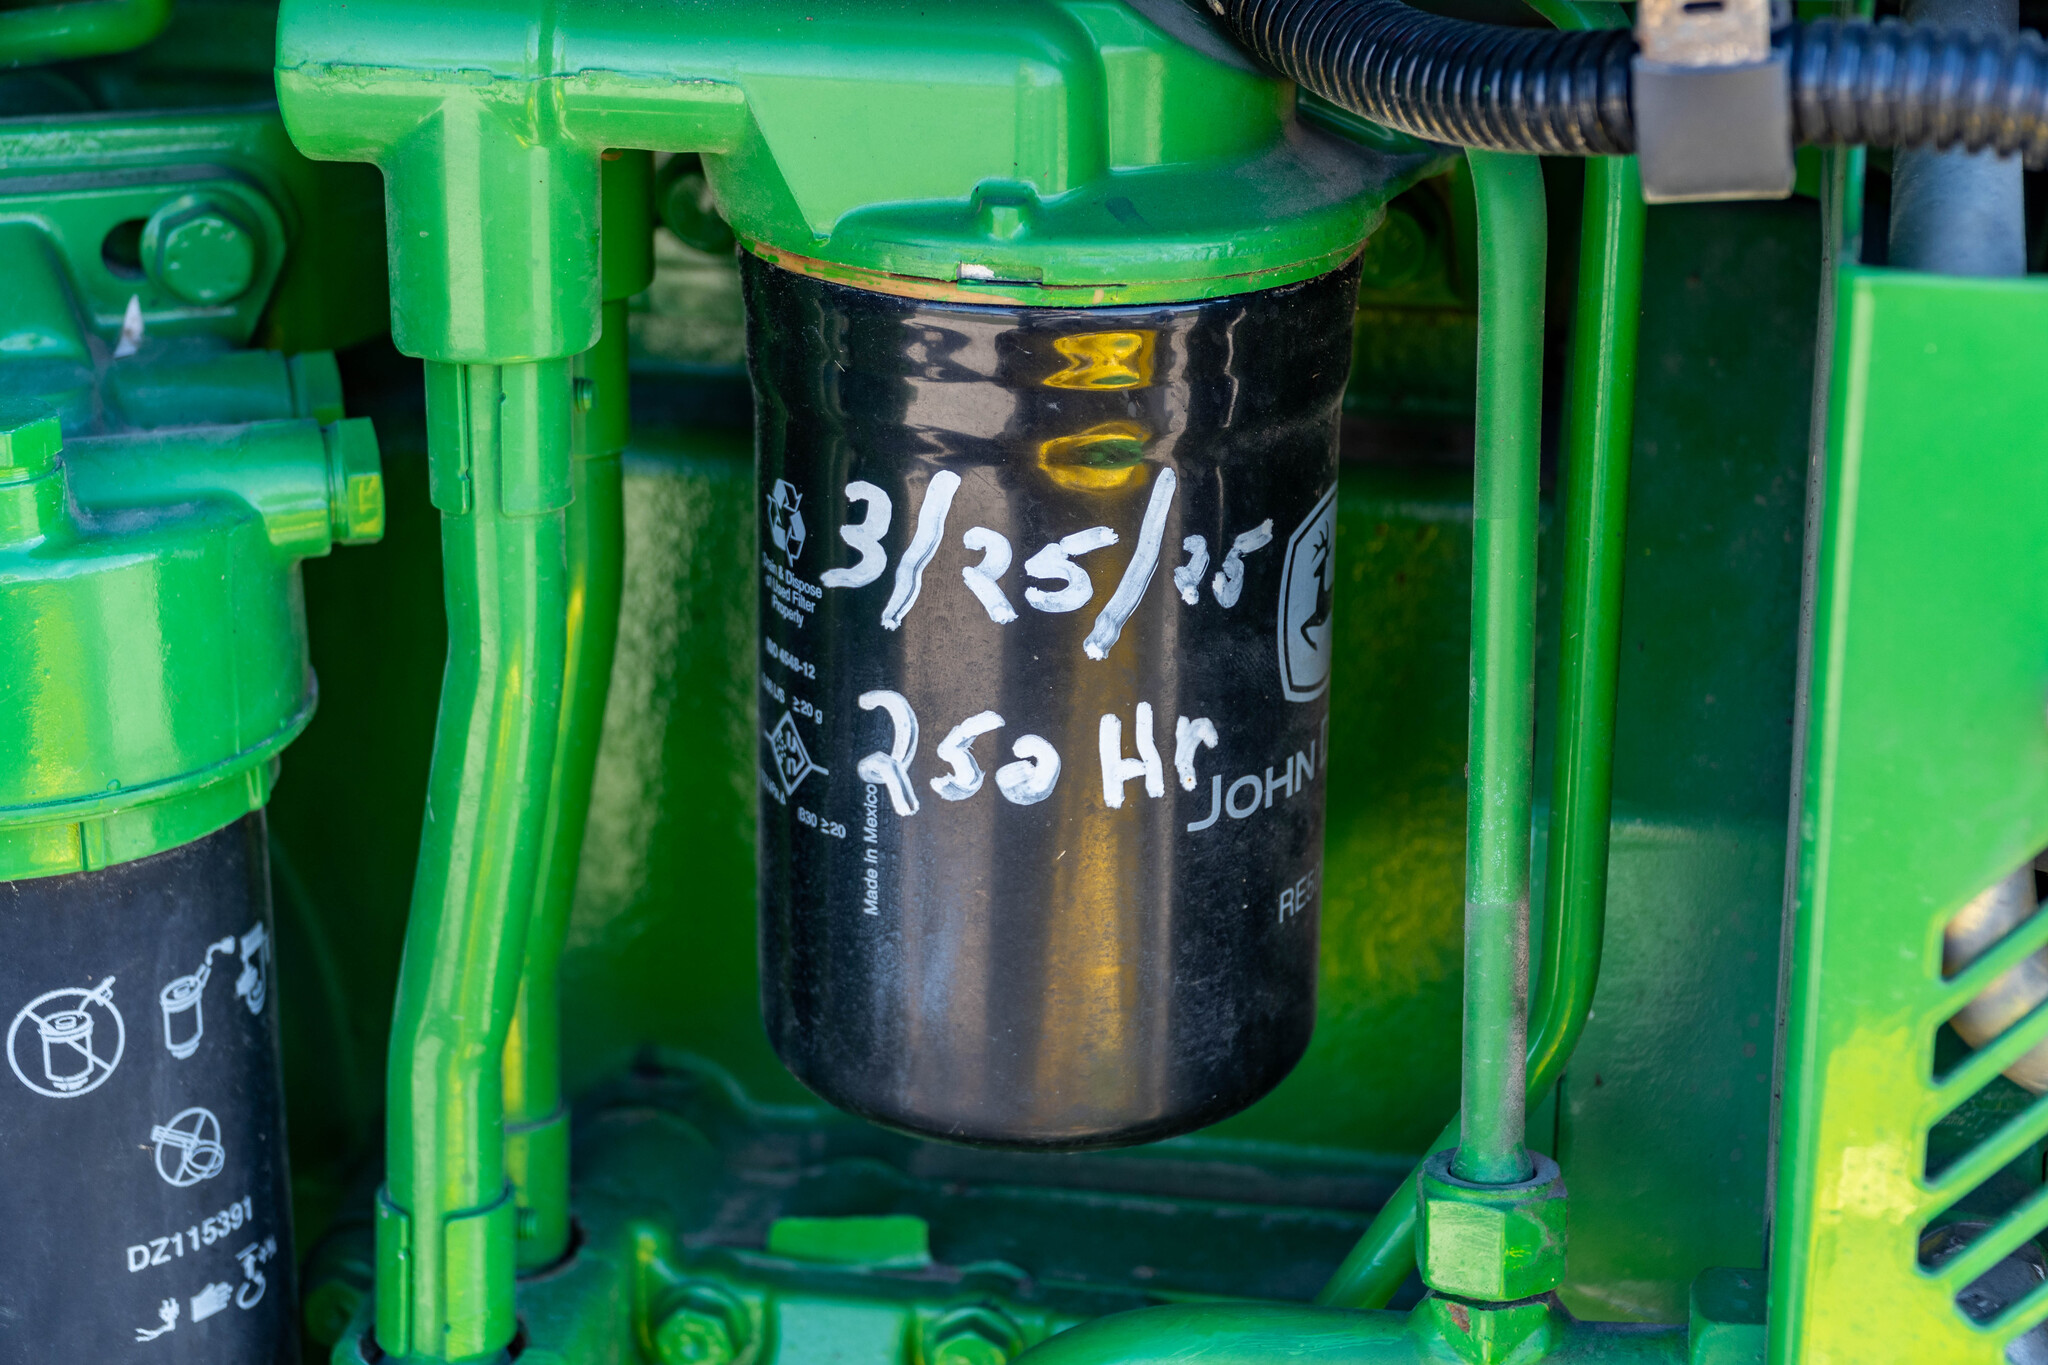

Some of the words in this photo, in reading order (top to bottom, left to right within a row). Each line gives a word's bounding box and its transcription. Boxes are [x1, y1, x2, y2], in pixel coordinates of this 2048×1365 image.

[785, 569, 823, 599] Dispose
[820, 467, 1274, 661] 3/25/25
[772, 578, 791, 601] Used
[791, 591, 816, 613] Filter
[858, 690, 1061, 816] 250
[1100, 702, 1219, 809] Hr
[863, 783, 878, 844] Mexico
[1186, 739, 1316, 832] JOHN
[863, 848, 878, 864] in
[863, 868, 878, 916] Made
[127, 1194, 253, 1273] DZ115391
